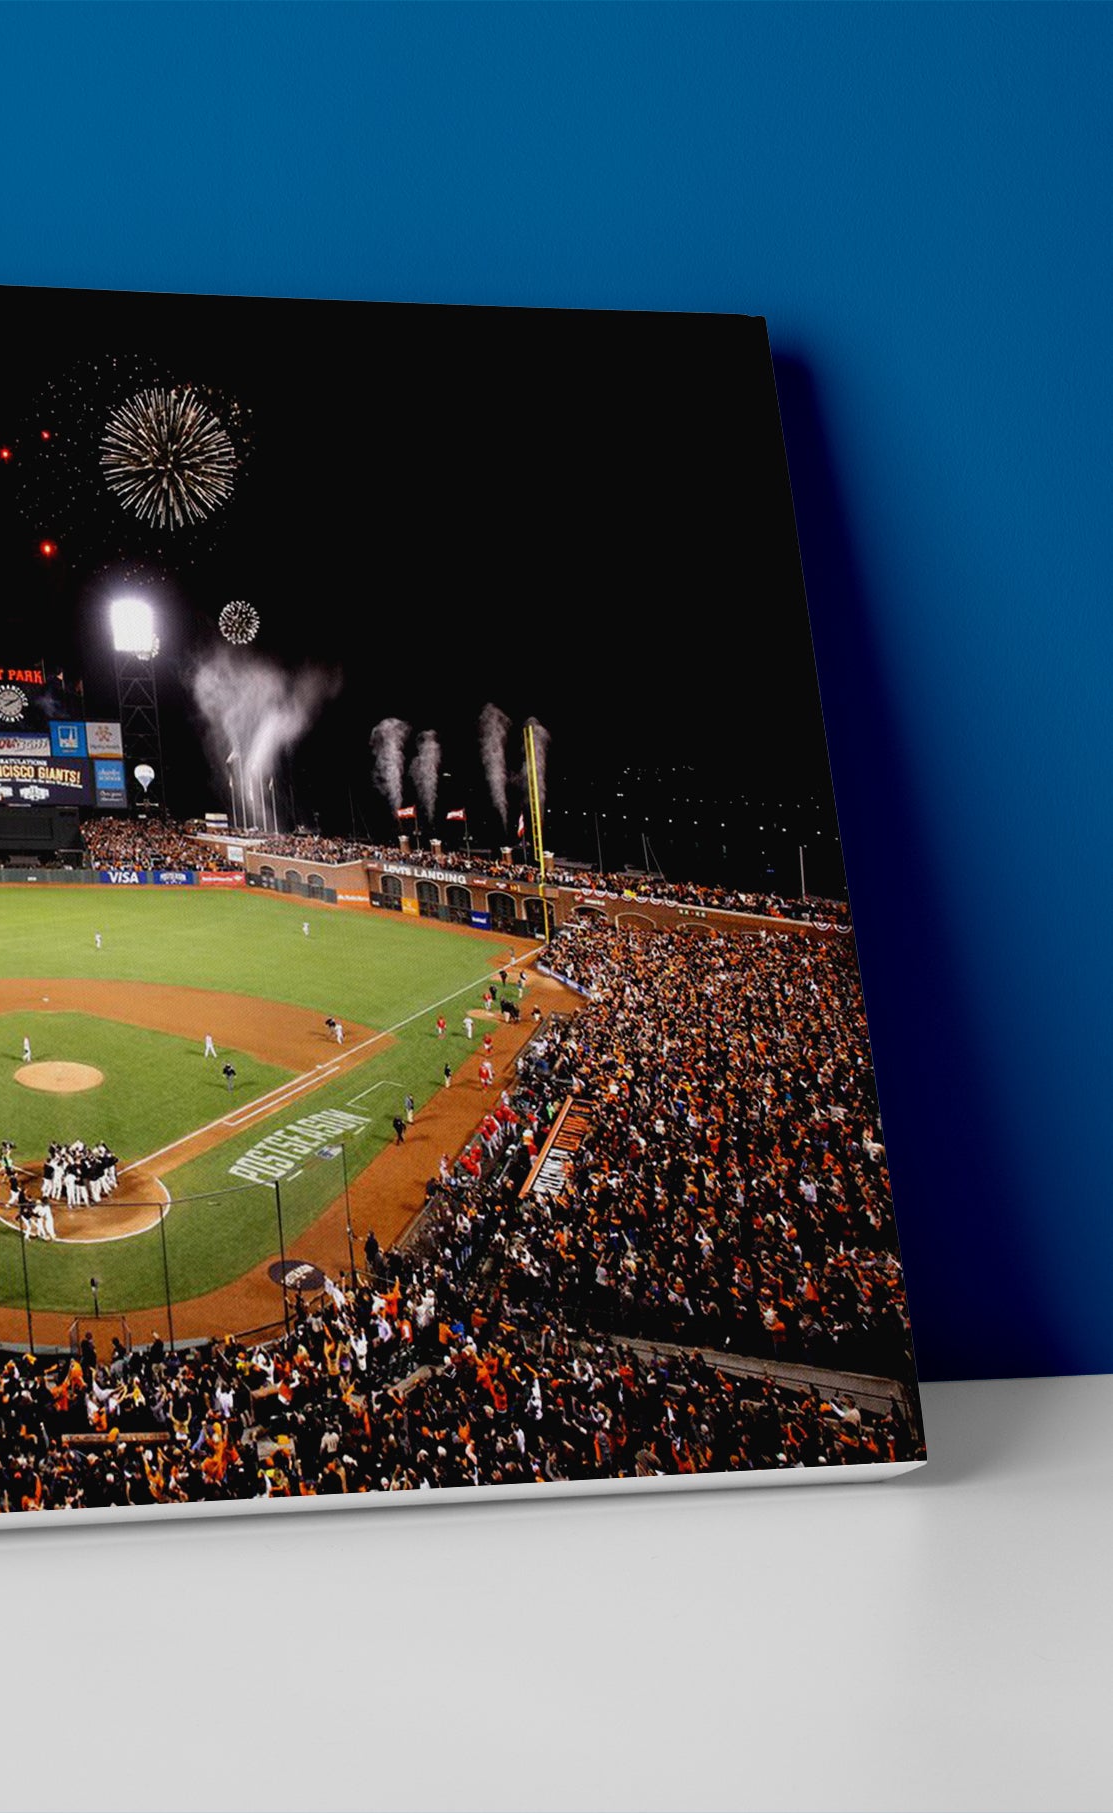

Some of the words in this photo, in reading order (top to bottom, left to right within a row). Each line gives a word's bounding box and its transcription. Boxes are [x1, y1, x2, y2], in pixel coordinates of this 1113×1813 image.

[8, 669, 44, 685] PARK
[37, 766, 81, 784] GIANTS!
[108, 871, 140, 884] VISA
[414, 868, 467, 885] LANDING
[228, 1108, 373, 1188] POSTSEASON
